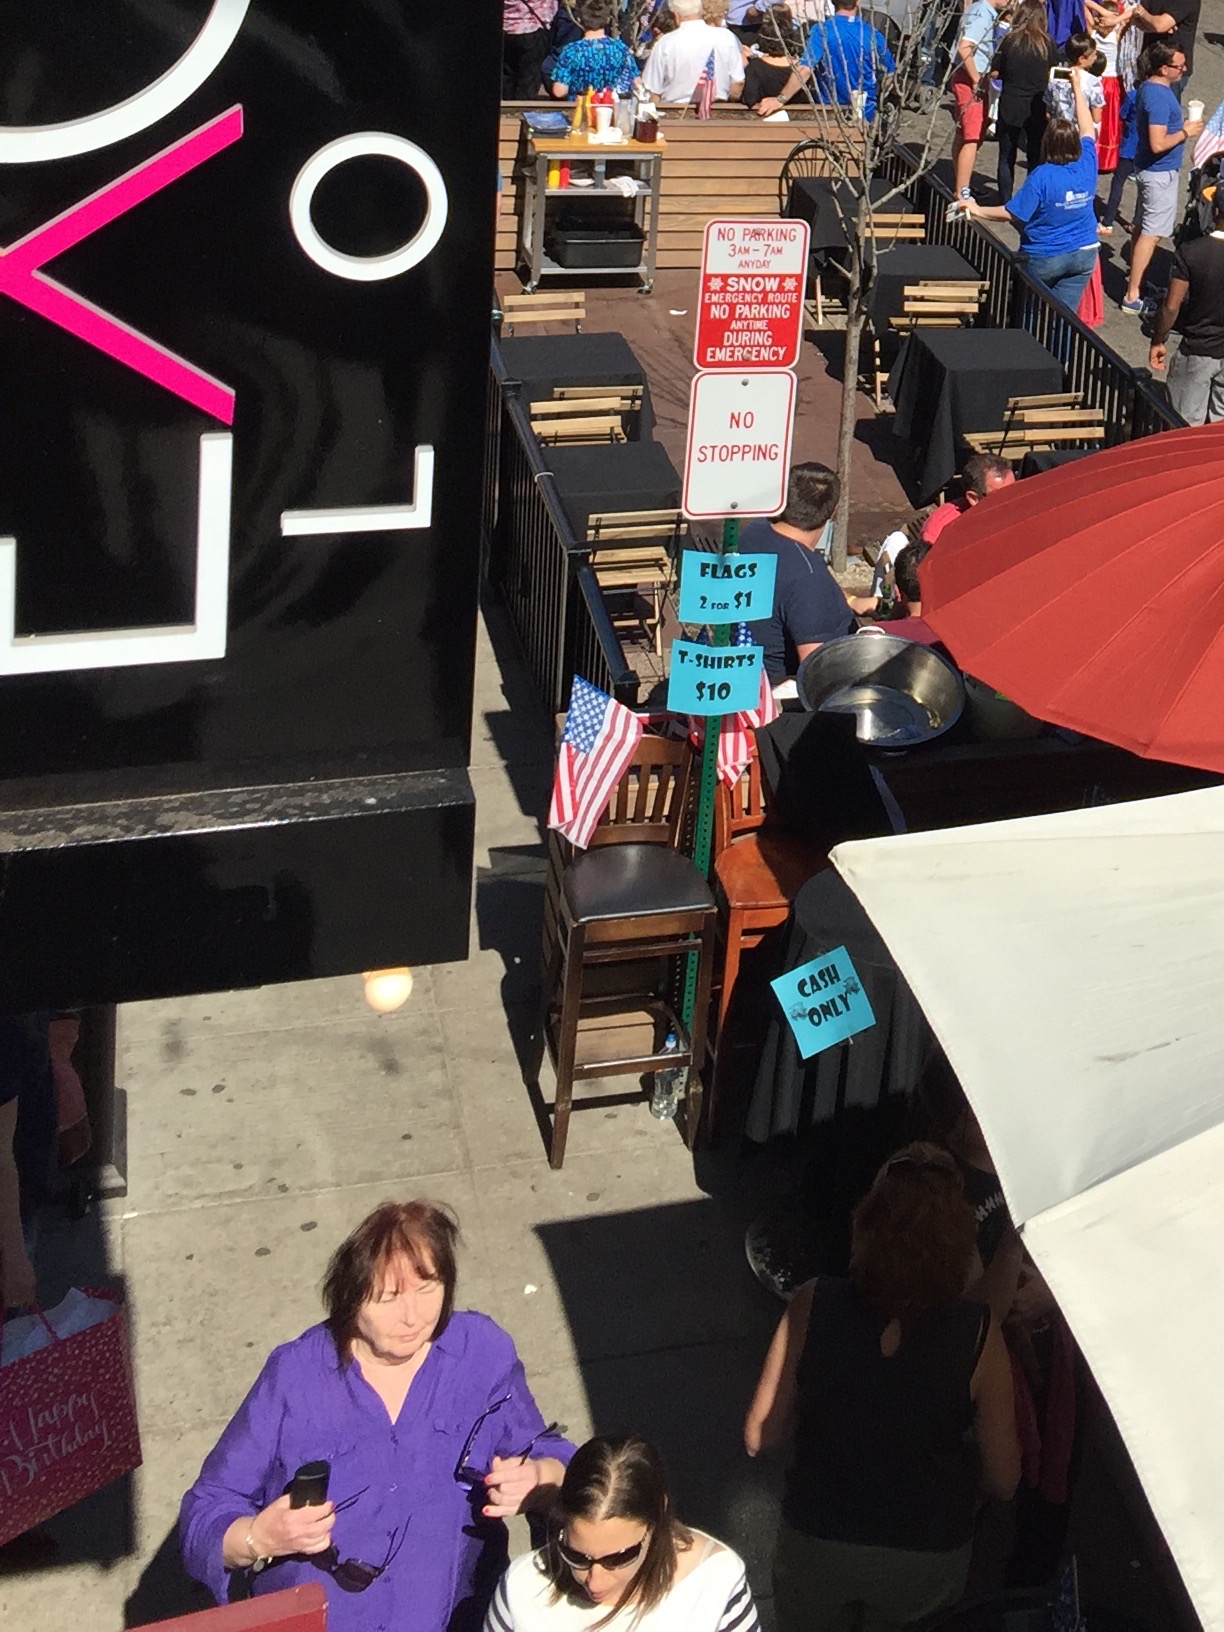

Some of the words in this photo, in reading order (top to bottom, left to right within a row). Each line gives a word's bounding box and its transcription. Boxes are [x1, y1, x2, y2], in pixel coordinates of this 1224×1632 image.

[717, 227, 736, 242] NO
[742, 227, 797, 243] PARKING
[738, 259, 772, 269] ANYDAY
[726, 276, 780, 292] SNOW
[704, 292, 764, 303] EMERGENCY
[767, 292, 798, 303] ROUTE
[710, 304, 729, 319] NO
[735, 304, 791, 319] PARKING
[730, 319, 769, 330] ANYTIME
[723, 331, 773, 346] DURING
[706, 346, 787, 362] EMERGENCY
[729, 411, 755, 429] NO
[697, 443, 779, 463] STOPPING
[700, 562, 758, 579] FLAGS
[699, 595, 708, 610] 2
[711, 602, 730, 610] FOR
[733, 590, 753, 610] $1
[678, 649, 756, 670] T-SHIRTS
[696, 680, 731, 702] $10
[797, 963, 841, 998] CASH
[807, 992, 851, 1028] ONLY
[9, 1391, 101, 1452] Happy
[1, 1420, 112, 1496] Birthday
